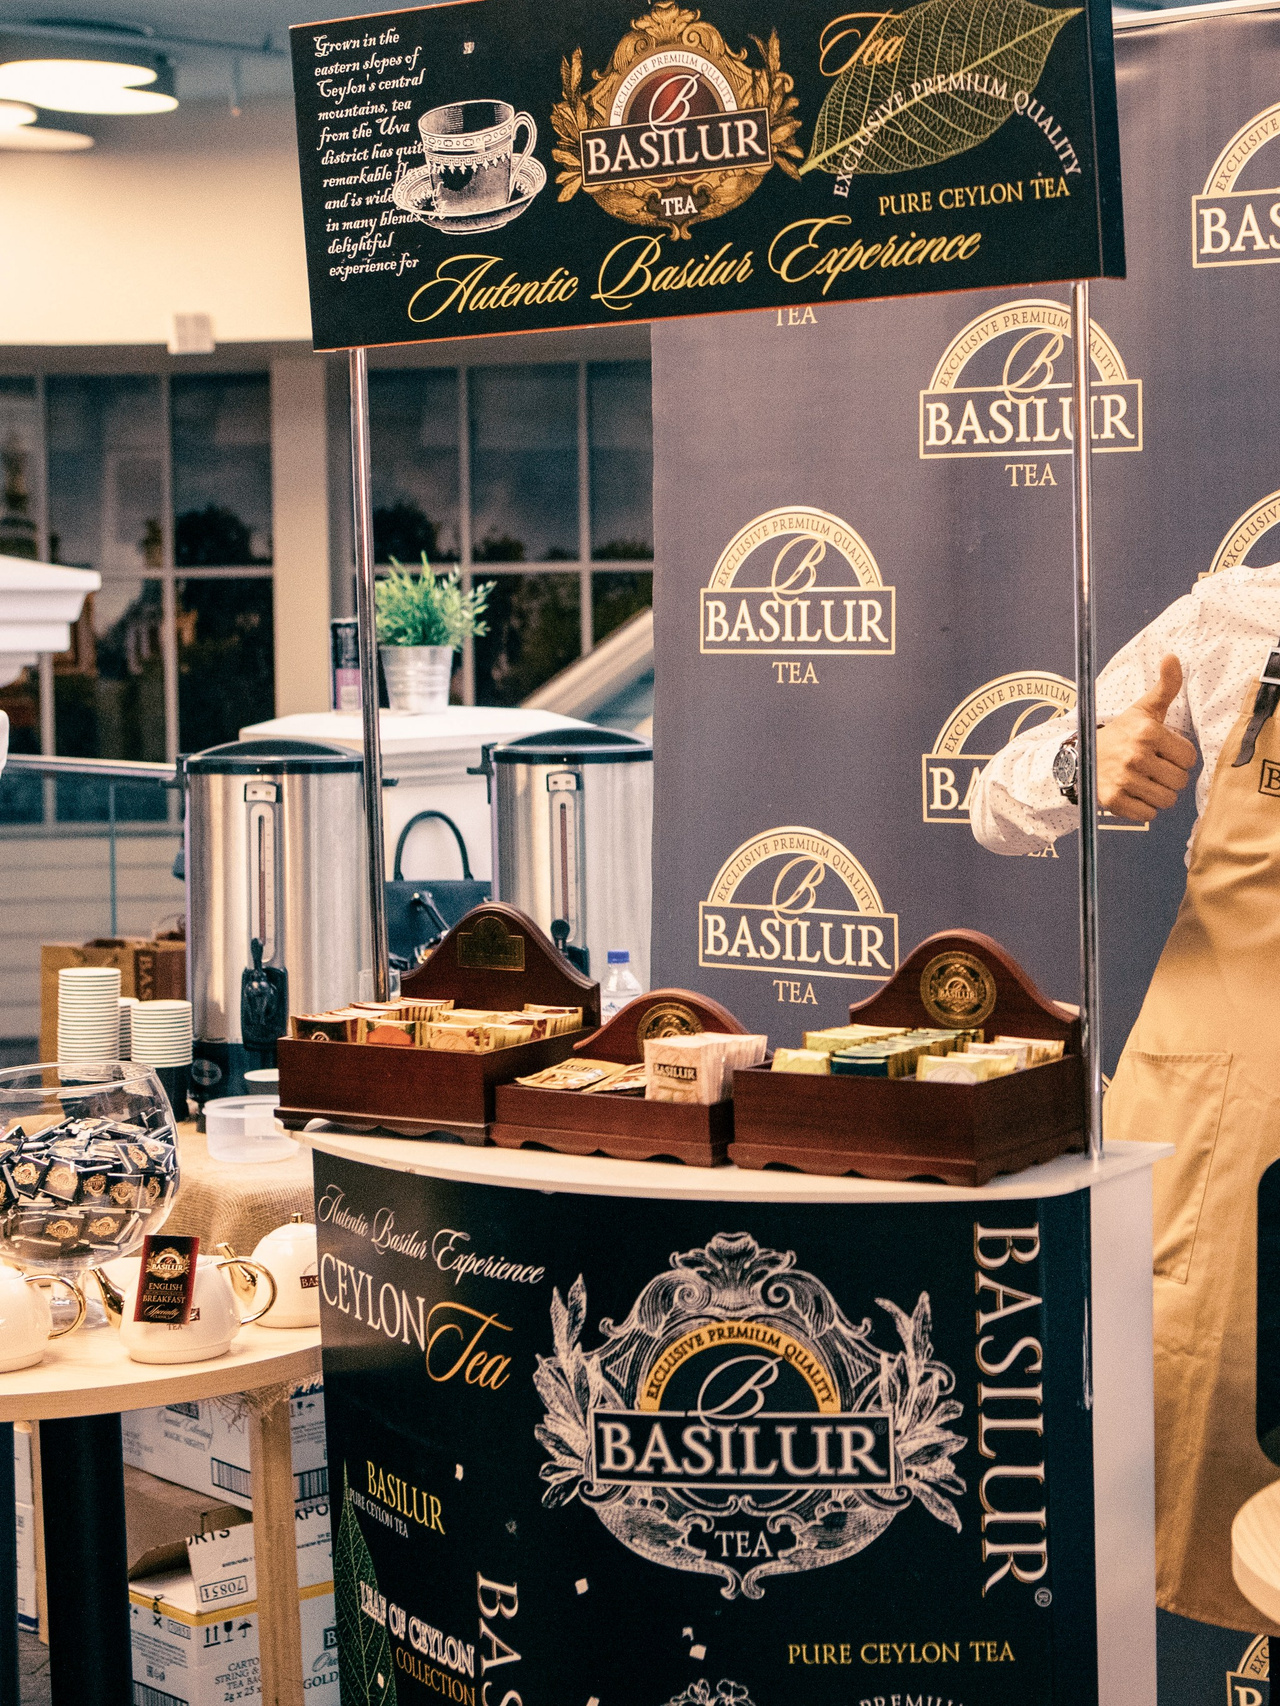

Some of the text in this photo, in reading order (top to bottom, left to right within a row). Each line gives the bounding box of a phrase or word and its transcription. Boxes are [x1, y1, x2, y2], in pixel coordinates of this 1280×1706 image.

[313, 27, 400, 57] Grown in the
[314, 46, 422, 76] eastern slopes of
[820, 9, 907, 77] Tea
[317, 68, 426, 105] Ceylon's central
[614, 54, 734, 117] EXCLUSIVE PREMIUM QUALITY
[318, 100, 412, 121] mountains, tea
[316, 127, 349, 150] from
[352, 122, 372, 139] the
[321, 148, 369, 165] district
[371, 143, 393, 160] has
[586, 119, 766, 176] BASILUR
[833, 72, 1083, 199] EXCLUSIVE PREMIUM QUALITY
[1215, 118, 1280, 192] EXCLUSIVE
[323, 164, 392, 187] remarkable
[325, 193, 352, 209] and
[351, 193, 362, 207] is
[661, 195, 698, 217] TEA
[879, 176, 1072, 216] PURE CEYLON TEA
[326, 219, 339, 232] in
[342, 217, 377, 237] many
[328, 232, 395, 259] delightful
[329, 253, 419, 282] experience for
[408, 215, 983, 323] Autentic Basilur Experience
[774, 307, 818, 326] TEA
[940, 319, 1000, 388] EXCLUSIVE
[1002, 311, 1069, 329] PREMIUM
[1005, 463, 1058, 487] TEA
[718, 517, 874, 587] EXCLUSIVE PREMIUM QUALITY
[706, 599, 889, 643] BASILUR
[772, 661, 819, 683] TEA
[944, 682, 1071, 754] EXCLUSIVE PREMIUM
[718, 837, 874, 911] EXCLUSIVE PREMIUM QUALITY
[704, 914, 892, 969] BASILUR
[773, 980, 818, 1005] TEA
[318, 1184, 547, 1286] Autentic Basilur Experience
[142, 1295, 186, 1304] BREAKFAST
[148, 1282, 183, 1291] ENGLISH
[320, 1253, 426, 1352] CEYLON
[426, 1301, 514, 1391] Tea
[646, 1327, 835, 1406] EXCLUSIVE PREMIUM QUALITY
[974, 1221, 1047, 1599] BASILUR
[598, 1422, 888, 1476] BASILUR
[366, 1460, 446, 1535] BASILUR
[366, 1500, 393, 1528] CEYLON
[393, 1517, 409, 1538] TEA
[714, 1530, 774, 1558] TEA
[408, 1616, 475, 1678] CEYLON
[788, 1641, 1016, 1665] PURE CEYLON TEA
[396, 1647, 476, 1706] COLLECTION
